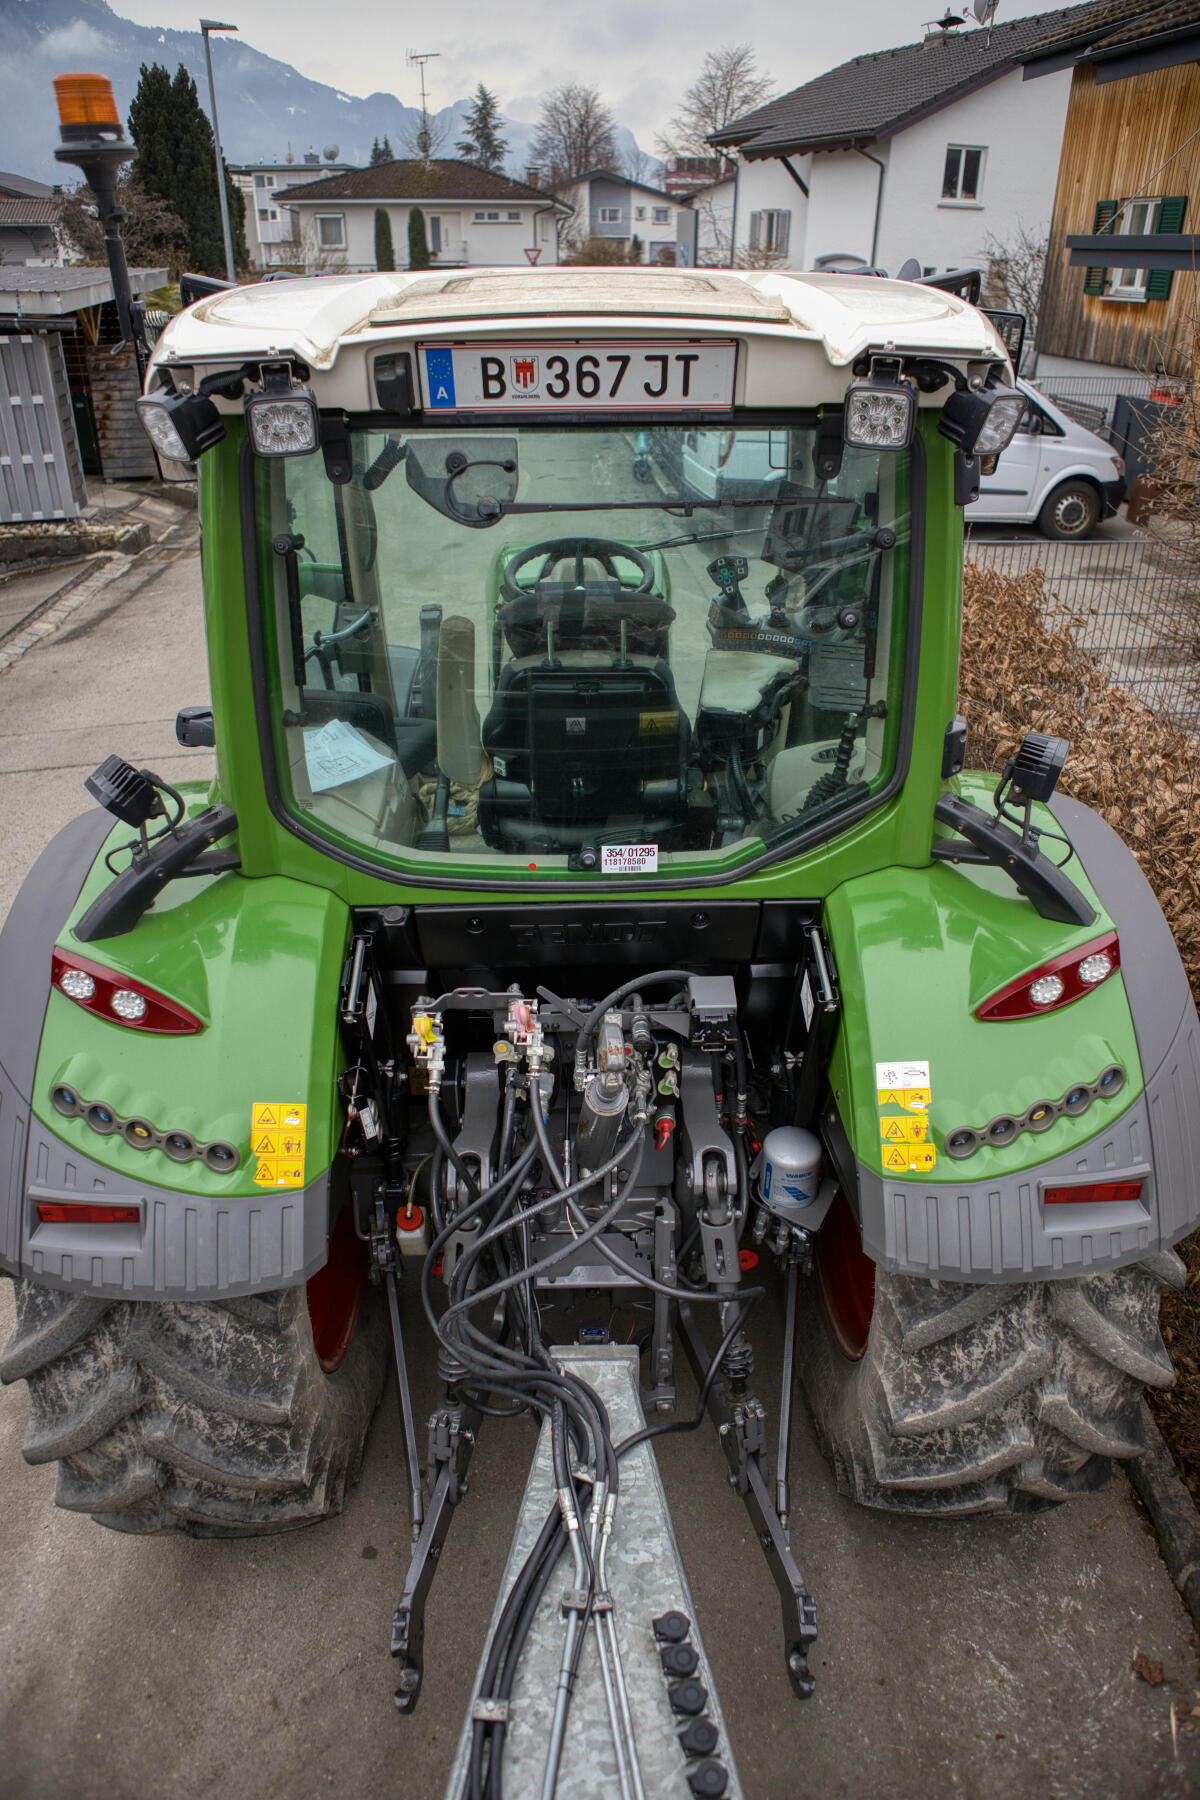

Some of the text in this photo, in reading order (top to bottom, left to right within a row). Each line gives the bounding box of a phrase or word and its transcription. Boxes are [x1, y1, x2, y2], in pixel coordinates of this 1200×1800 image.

[480, 354, 700, 400] B 367 JT
[436, 386, 449, 400] A
